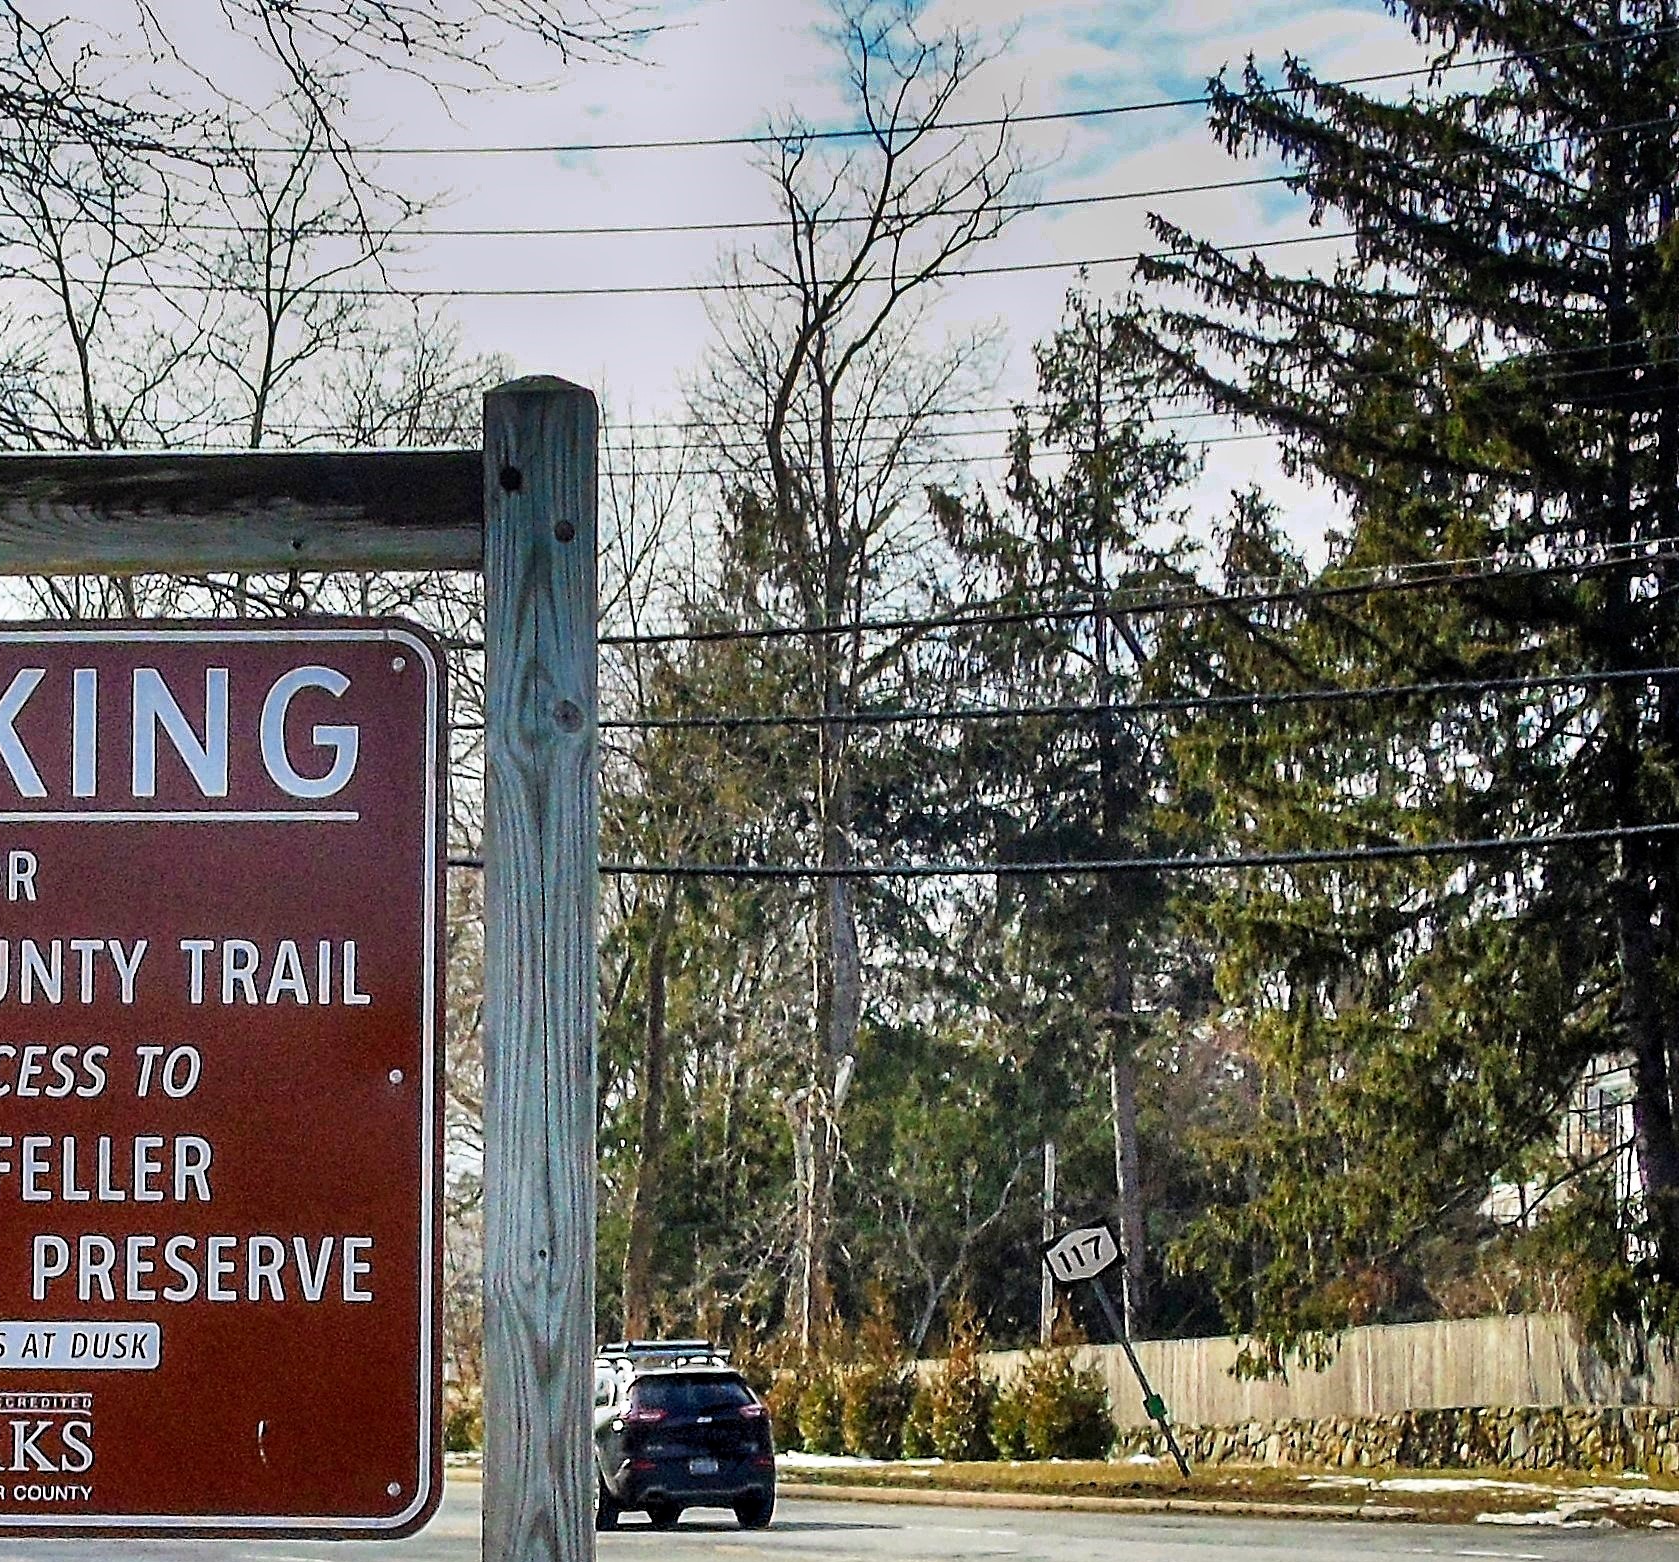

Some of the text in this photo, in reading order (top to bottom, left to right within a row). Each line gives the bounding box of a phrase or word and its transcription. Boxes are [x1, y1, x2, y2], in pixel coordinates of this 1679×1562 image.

[181, 940, 370, 1004] TRAIL
[137, 1046, 200, 1097] TO
[34, 1236, 372, 1301] PRESERVE
[1058, 1235, 1101, 1273] 117
[22, 1333, 56, 1358] AT
[71, 1333, 147, 1358] DUSK
[14, 1485, 92, 1500] COUNTY
